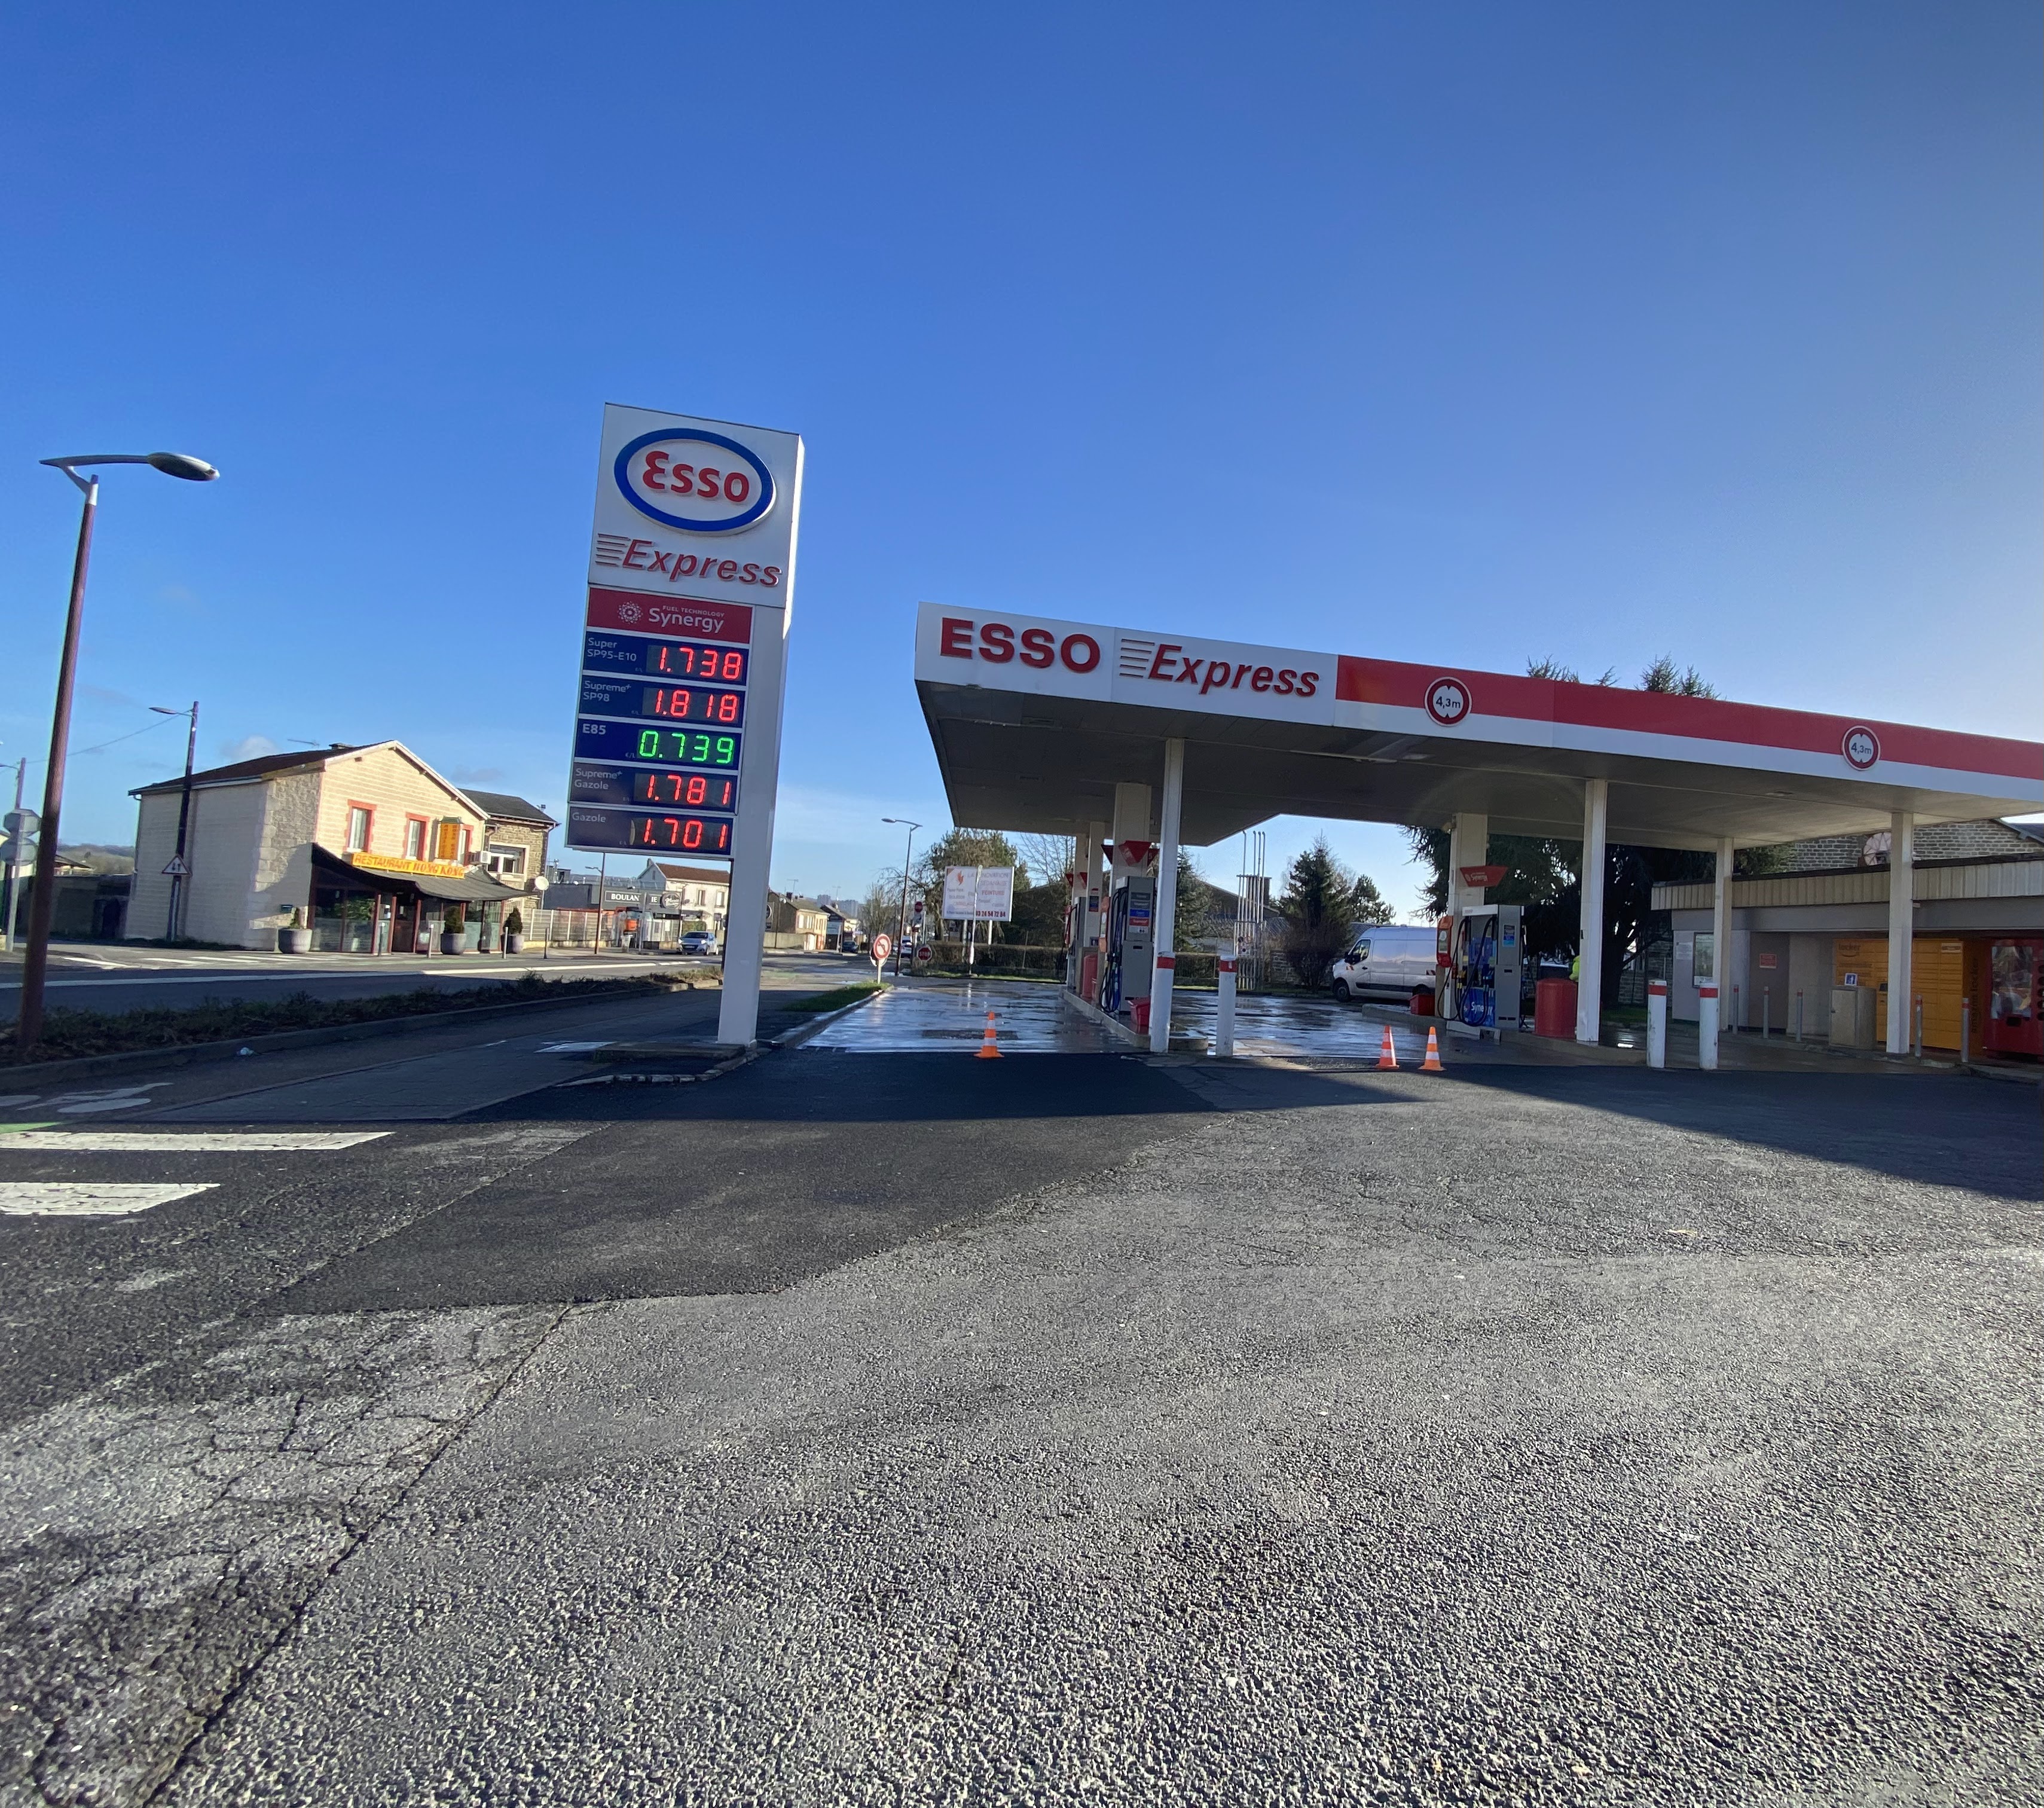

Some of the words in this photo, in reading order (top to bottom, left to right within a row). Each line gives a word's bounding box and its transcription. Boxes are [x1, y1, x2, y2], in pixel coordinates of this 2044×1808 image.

[622, 539, 782, 587] Express
[649, 607, 724, 633] Synergy
[681, 607, 725, 618] TECHNOLOGY
[586, 649, 637, 661] SP95-E10
[588, 637, 618, 648] Super
[940, 616, 1101, 673] ESSO
[659, 646, 743, 679] 1.738
[1148, 643, 1319, 697] Express
[583, 691, 610, 702] SP98
[655, 689, 738, 722] 1.818
[582, 723, 606, 735] E85
[639, 730, 734, 764] 0.739
[574, 779, 609, 790] Gazole
[647, 774, 731, 805] 1.781
[572, 812, 606, 823] Gazole
[643, 817, 728, 848] 1.701
[354, 854, 411, 868] RESTAURANT
